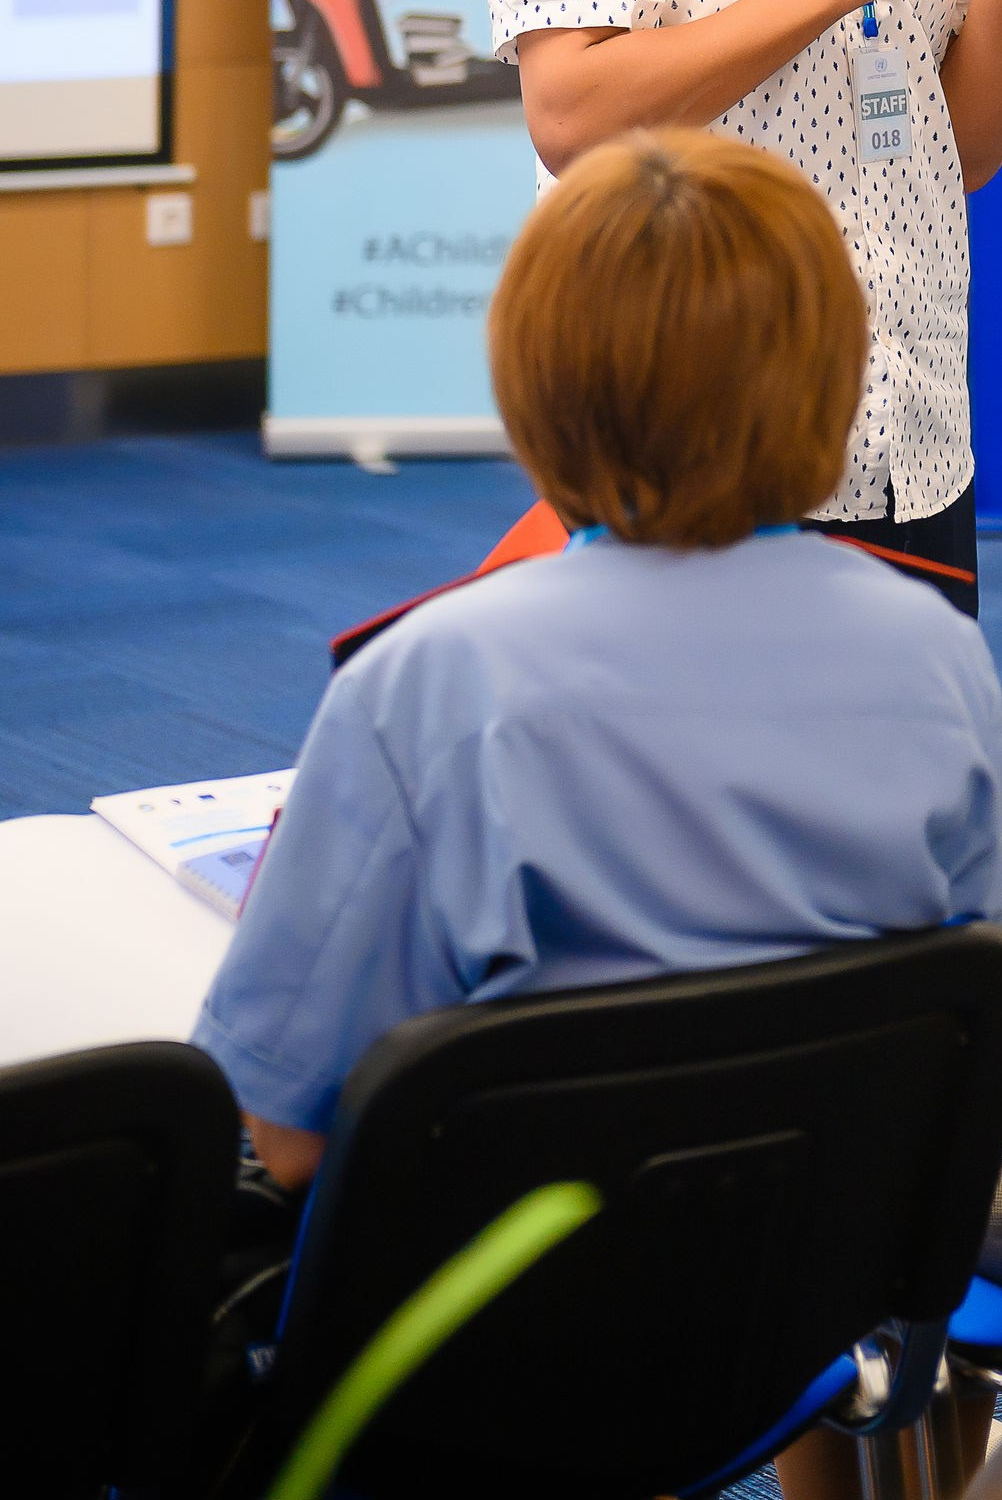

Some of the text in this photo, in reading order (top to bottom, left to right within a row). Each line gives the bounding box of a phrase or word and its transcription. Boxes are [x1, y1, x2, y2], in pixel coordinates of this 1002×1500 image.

[862, 95, 905, 116] STAFF
[872, 129, 901, 150] 018
[363, 232, 508, 264] #AChild
